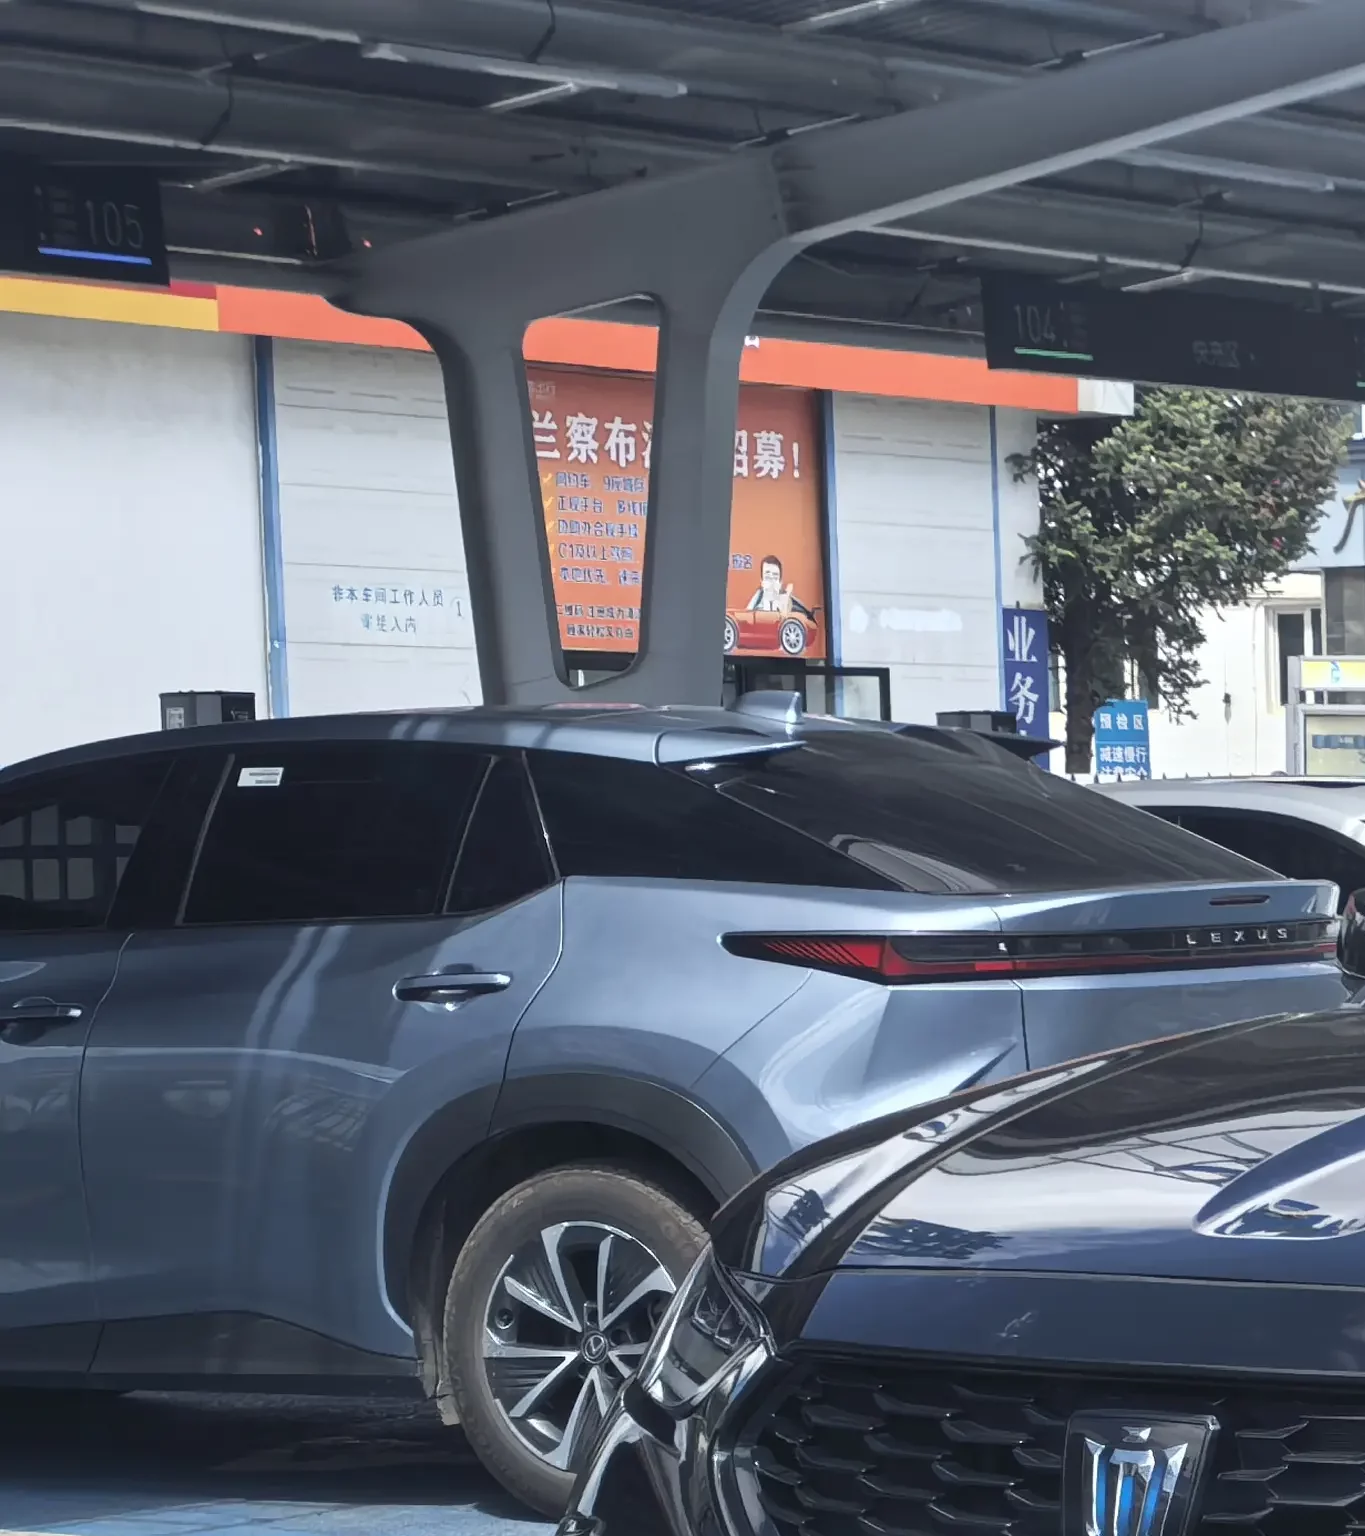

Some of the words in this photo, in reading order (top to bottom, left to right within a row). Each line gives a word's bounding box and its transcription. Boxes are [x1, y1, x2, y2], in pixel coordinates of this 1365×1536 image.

[85, 200, 144, 249] 105
[532, 409, 653, 469] 兰察布
[1005, 615, 1040, 736] 业务
[1100, 713, 1145, 731] 预检区
[1100, 746, 1147, 764] 减速慢行
[1186, 927, 1289, 945] LEXUS
